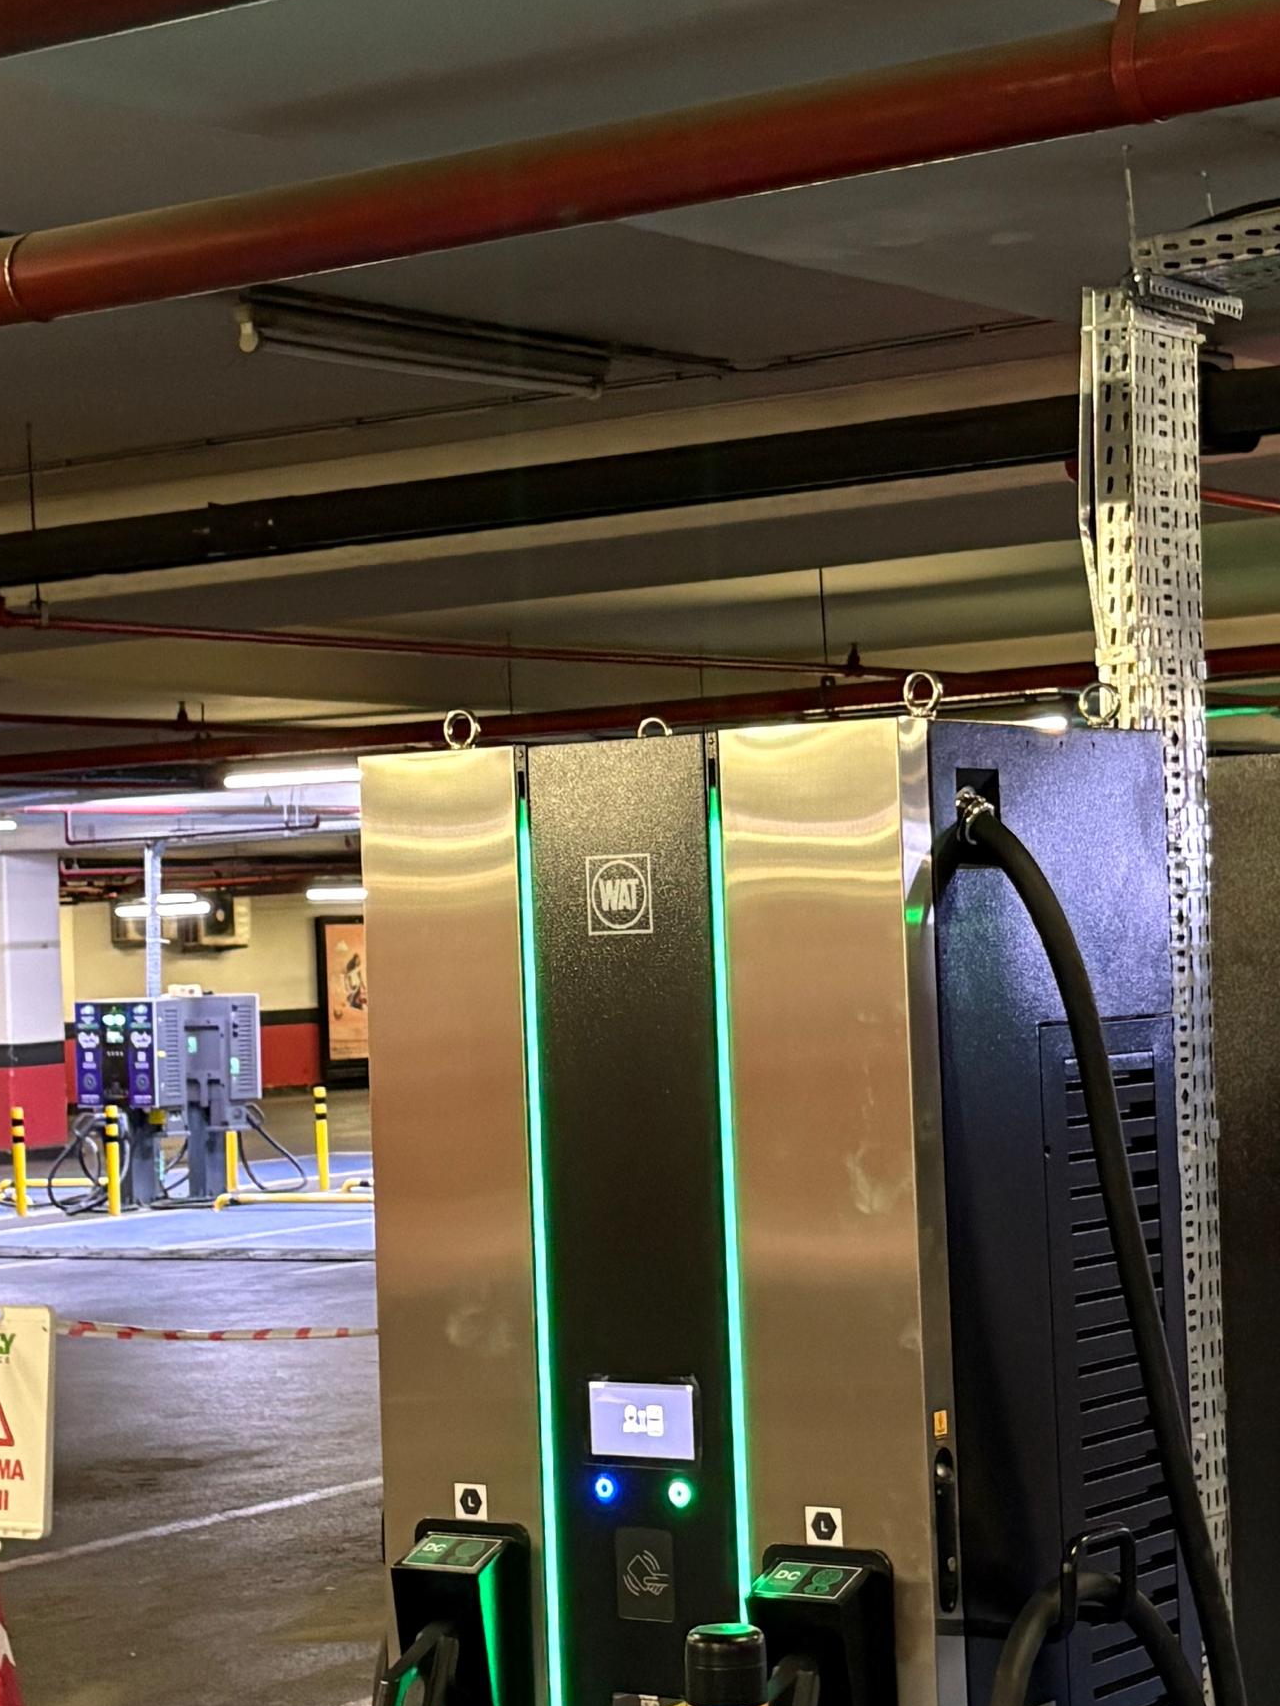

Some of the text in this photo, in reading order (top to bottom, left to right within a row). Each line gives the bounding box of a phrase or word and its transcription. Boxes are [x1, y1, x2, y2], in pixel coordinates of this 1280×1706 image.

[599, 878, 639, 911] WAT
[422, 1542, 447, 1552] DC
[774, 1570, 800, 1580] DC
